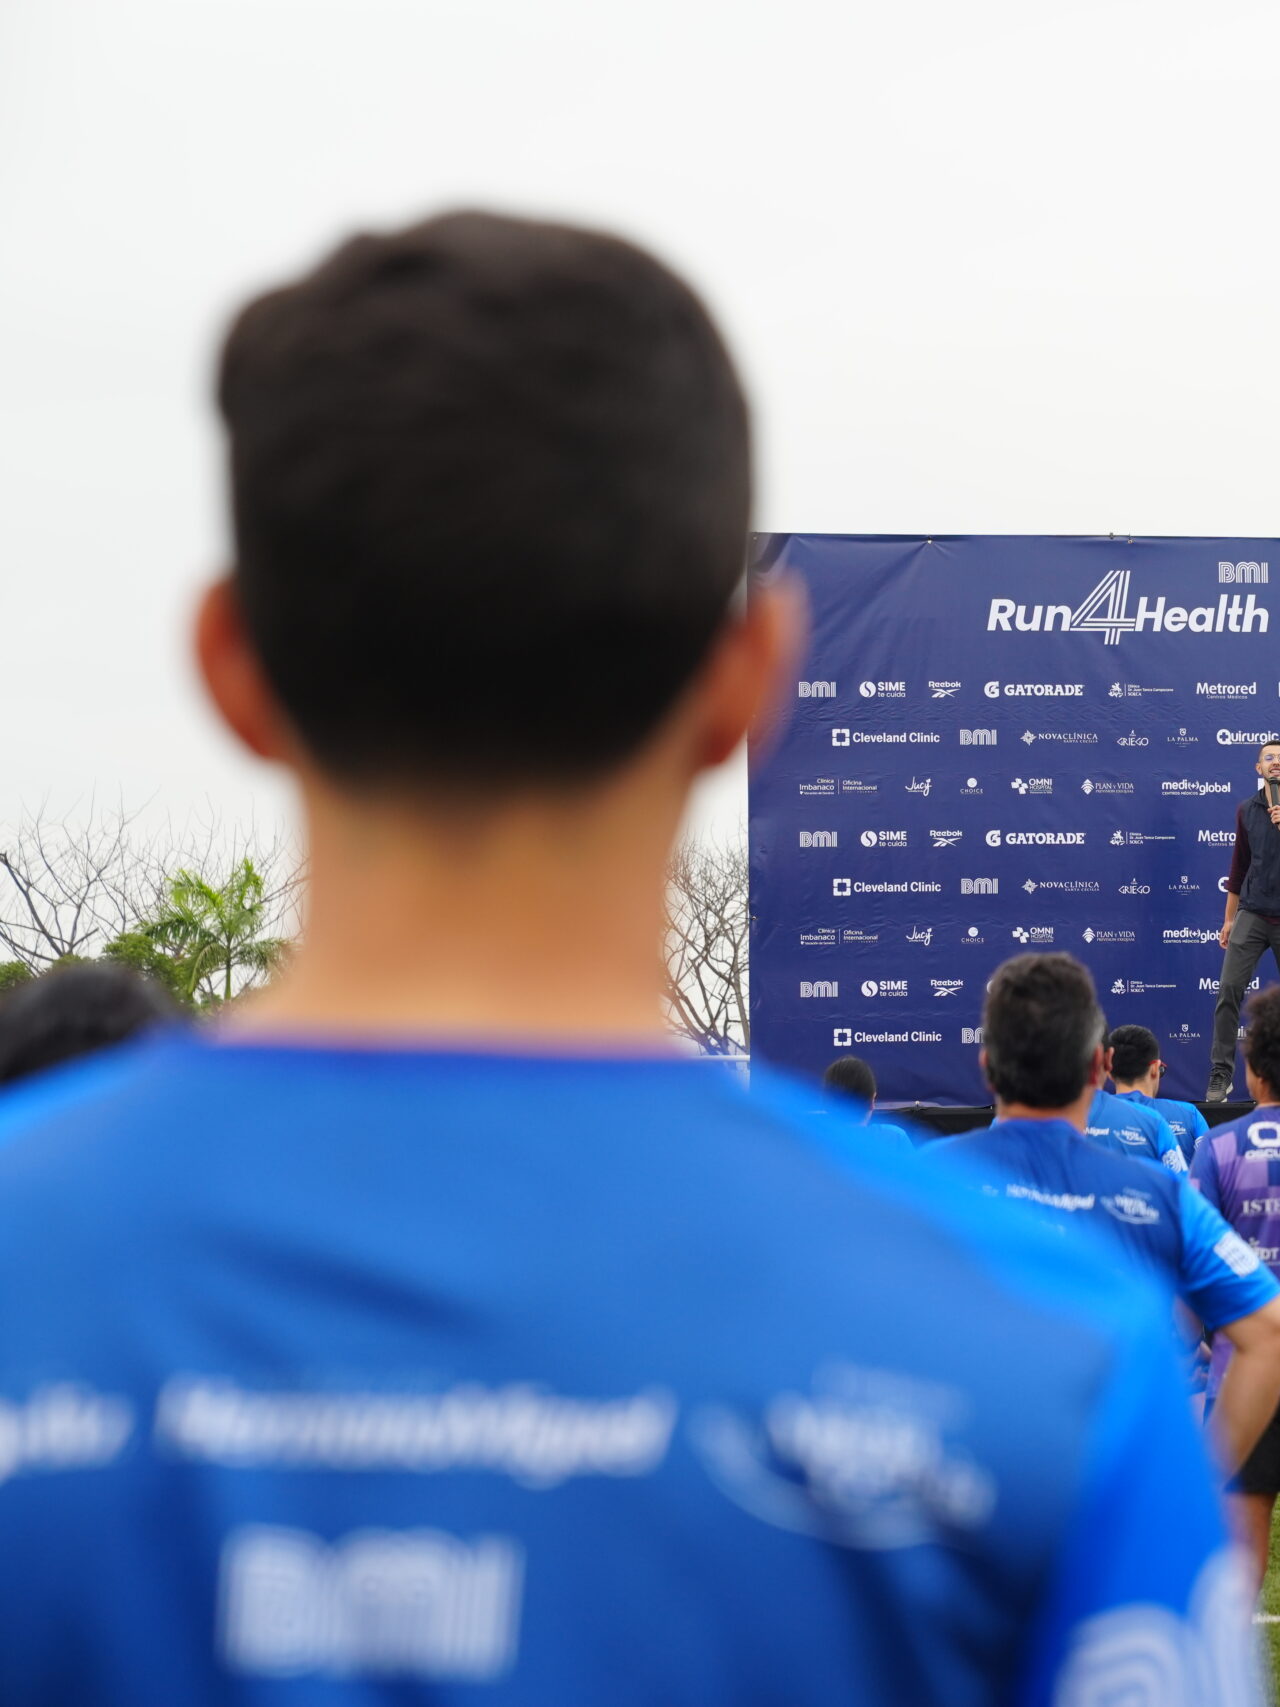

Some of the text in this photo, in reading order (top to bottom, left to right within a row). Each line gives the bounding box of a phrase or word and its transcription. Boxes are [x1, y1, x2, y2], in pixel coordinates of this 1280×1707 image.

[1218, 562, 1269, 584] BMI
[987, 570, 1269, 645] Run4Health
[799, 681, 837, 698] BMI
[878, 682, 906, 691] SIME
[928, 681, 962, 689] Reebok
[1004, 684, 1084, 697] GATORADE
[1196, 682, 1257, 694] Metrored
[853, 732, 940, 743] Cleveland Clinic
[960, 729, 997, 745] BMI
[1038, 732, 1098, 740] NOVACLÍNICA
[800, 832, 838, 848] BMI
[879, 831, 907, 841] SIME
[930, 830, 963, 838] Reebok
[1006, 832, 1085, 845] GATORADE
[1198, 830, 1236, 842] Metro
[854, 882, 942, 893] Cleveland Clinic
[961, 878, 999, 894] BMI
[1030, 927, 1054, 935] OMNI
[800, 981, 839, 998] BMI
[880, 981, 908, 990] SIME
[854, 1031, 942, 1043] Cleveland Clinic
